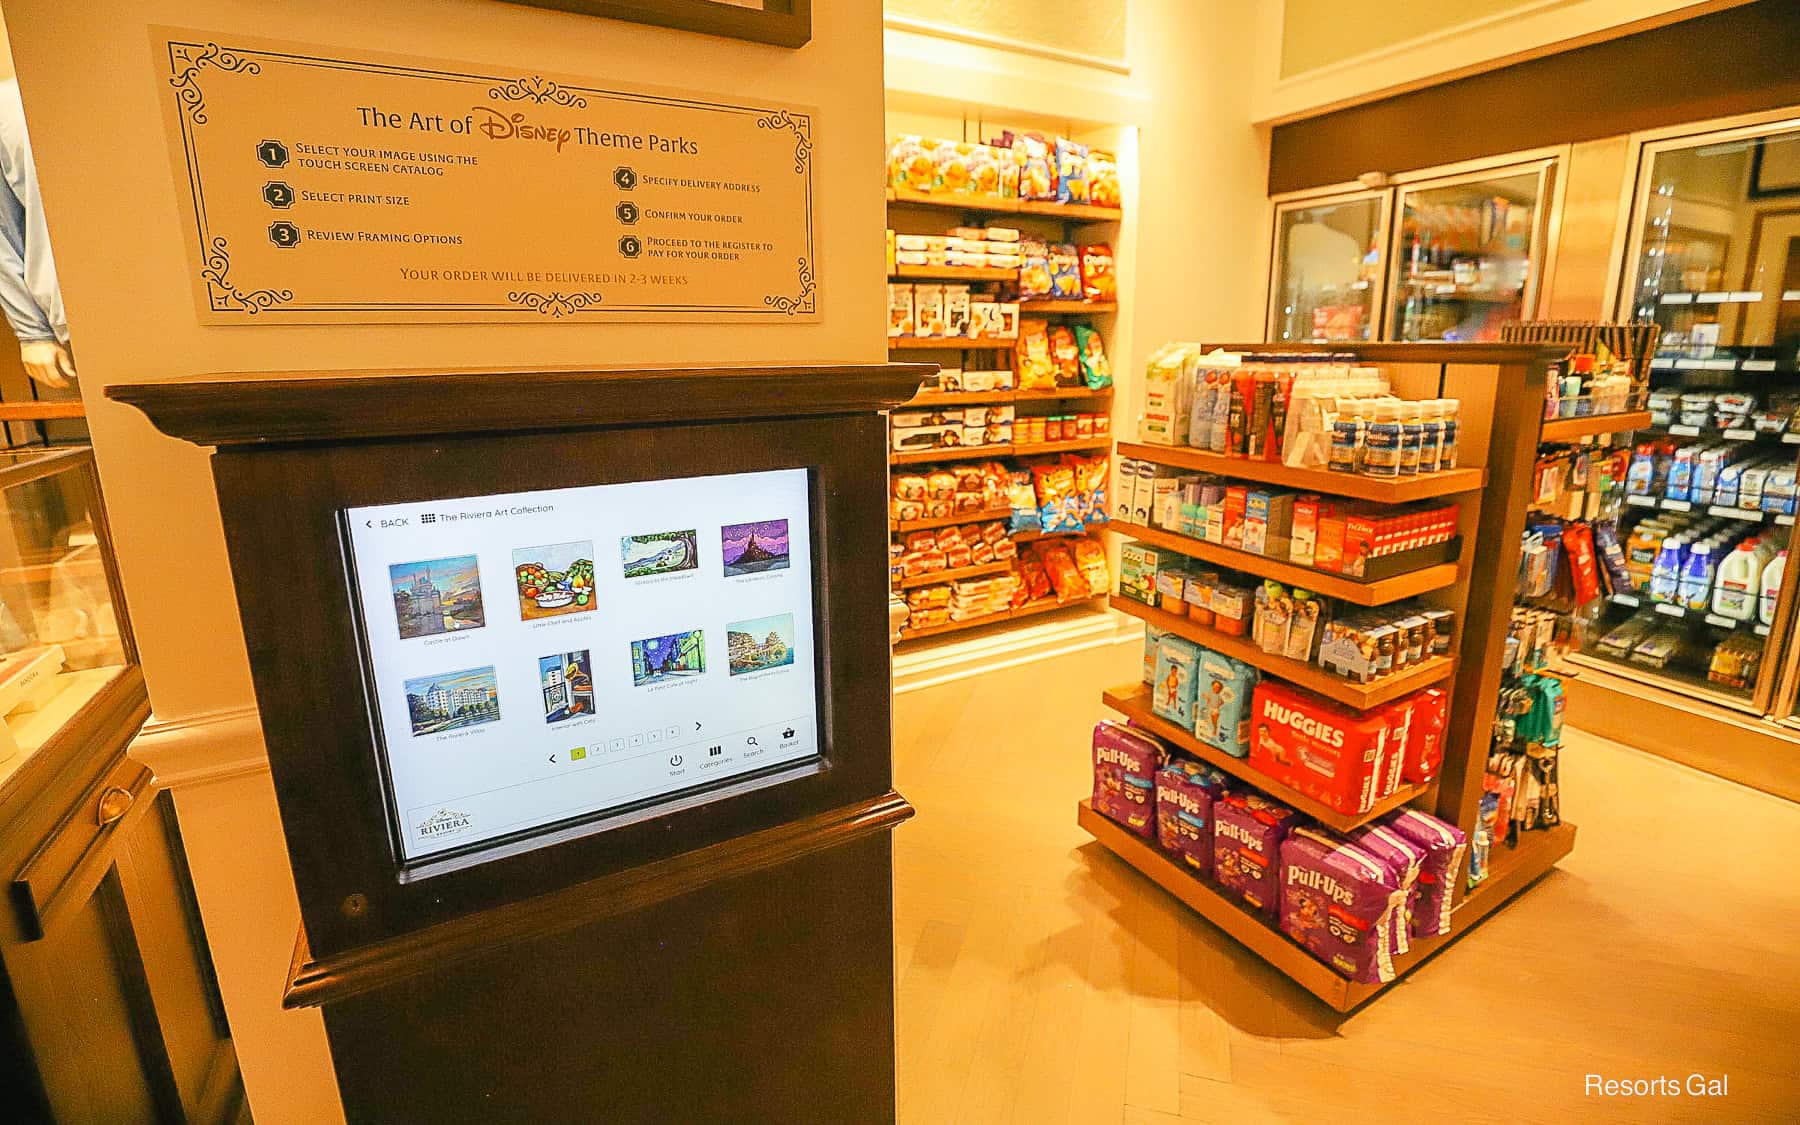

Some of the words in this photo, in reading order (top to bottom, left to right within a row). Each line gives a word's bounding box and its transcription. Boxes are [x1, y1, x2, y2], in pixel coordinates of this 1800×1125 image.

[357, 107, 402, 129] The
[409, 112, 443, 132] Art
[450, 115, 473, 134] of
[472, 106, 571, 153] Disney
[574, 128, 643, 150] Theme
[649, 134, 698, 155] Parks
[268, 148, 277, 161] 1
[296, 142, 339, 156] SELECT
[342, 147, 376, 159] YOUR
[379, 149, 415, 161] IMAGE
[419, 152, 454, 164] USING
[457, 155, 478, 166] THE
[298, 158, 341, 170] TOUCH
[345, 161, 389, 173] SCREEN
[392, 163, 444, 176] CATALOG
[620, 171, 630, 186] 4
[642, 174, 678, 187] SPECIFY
[681, 178, 721, 190] DELIVERY
[723, 182, 761, 193] ADDRESS
[273, 189, 284, 201] 2
[302, 190, 344, 203] SELECT
[348, 193, 383, 205] PRINT
[385, 195, 410, 205] SIZE
[622, 206, 633, 220] 5
[644, 208, 686, 221] CONFIRM
[689, 212, 713, 223] YOUR
[714, 214, 743, 224] ORDER
[279, 229, 290, 241] 3
[307, 229, 354, 242] REVIEW
[358, 231, 410, 244] FRAMING
[413, 233, 463, 244] OPTIONS
[625, 240, 635, 254] 6
[647, 236, 688, 249] PROCEED
[690, 239, 702, 249] TO
[704, 240, 721, 250] THE
[722, 241, 760, 252] REGISTER
[762, 242, 774, 252] TO
[648, 249, 664, 259] PAY
[666, 250, 683, 260] FOR
[685, 250, 709, 261] YOUR
[711, 251, 740, 262] ORDER
[400, 268, 439, 281] YOUR
[443, 270, 488, 281] ORDER
[491, 271, 524, 282] WILL
[527, 272, 542, 282] BE
[545, 271, 612, 284] DELIVERED
[614, 272, 626, 284] IN
[629, 273, 648, 285] 2-3
[650, 274, 689, 286] WEEKS
[440, 512, 458, 523] The
[460, 510, 492, 521] Riviera
[494, 508, 508, 518] Art
[510, 504, 554, 516] Collection
[380, 517, 409, 529] BACK
[1263, 700, 1345, 748] HUGGIES
[743, 748, 764, 759] Search
[699, 756, 733, 770] Categories
[421, 818, 469, 835] RIVIERA
